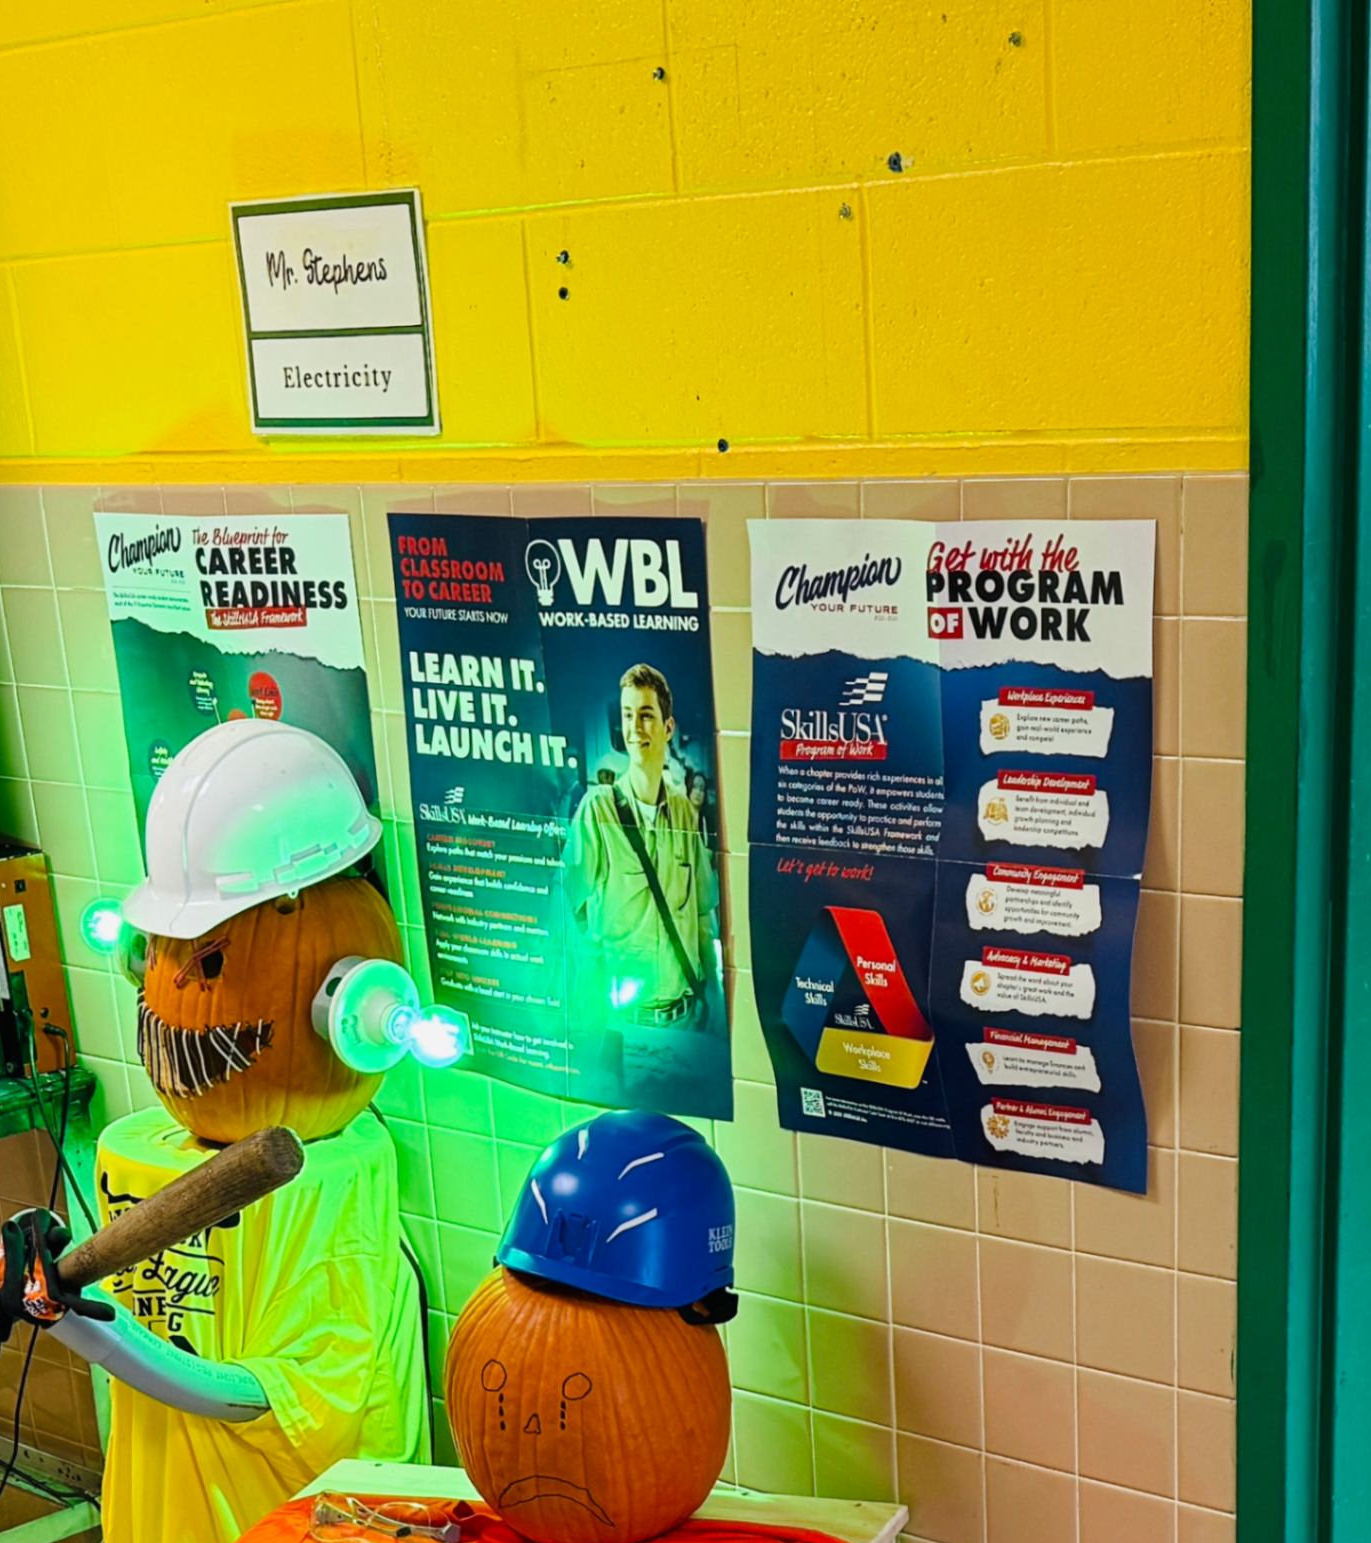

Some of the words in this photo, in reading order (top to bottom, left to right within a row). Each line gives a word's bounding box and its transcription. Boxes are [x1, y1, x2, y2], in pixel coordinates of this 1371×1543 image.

[266, 250, 298, 291] Mr.
[303, 248, 388, 295] Stephens
[283, 364, 392, 393] Electricity
[108, 523, 181, 573] Champion
[212, 527, 269, 550] Blueprint
[270, 526, 289, 546] for
[398, 535, 447, 556] FROM
[195, 547, 298, 575] CAREER
[927, 540, 971, 572] Get
[979, 533, 1035, 573] with
[1041, 533, 1080, 574] the
[400, 558, 504, 582] CLASSROOM
[557, 538, 699, 609] WBL
[402, 580, 425, 601] TO
[429, 582, 492, 603] CAREER
[775, 553, 902, 611] Champion
[926, 570, 1125, 605] PROGRAM
[200, 580, 348, 609] READINESS
[404, 606, 427, 620] YOUR
[428, 608, 457, 621] FUTURE
[458, 609, 485, 623] STARTS
[486, 611, 508, 624] NOW
[810, 602, 845, 613] YOUR
[850, 604, 899, 615] FUTURE
[539, 611, 629, 629] WORK-BASED
[633, 614, 699, 632] LEARNING
[930, 611, 960, 636] OF
[969, 606, 1092, 642] WORK
[409, 651, 504, 689] LEARN
[510, 658, 544, 693] IT.
[412, 687, 475, 723] LIVE
[481, 693, 518, 727] IT.
[415, 723, 534, 765] LAUNCH
[539, 735, 578, 769] IT.
[796, 743, 834, 760] Program
[837, 744, 846, 758] of
[849, 742, 873, 756] Work
[778, 766, 799, 776] When
[806, 766, 833, 779] chapter
[835, 770, 866, 781] provides
[867, 772, 880, 781] rich
[882, 775, 926, 785] experiences
[789, 783, 824, 792] categories
[876, 787, 914, 799] empowers
[867, 799, 888, 810] These
[817, 812, 858, 823] opportunity
[777, 858, 802, 874] Let's
[805, 862, 827, 882] get
[841, 865, 875, 881] work!
[856, 956, 897, 973] Personal
[795, 976, 835, 993] Technical
[864, 973, 888, 988] Skills
[804, 993, 827, 1006] Skills
[842, 1042, 891, 1061] Workplace
[858, 1059, 882, 1073] Skills
